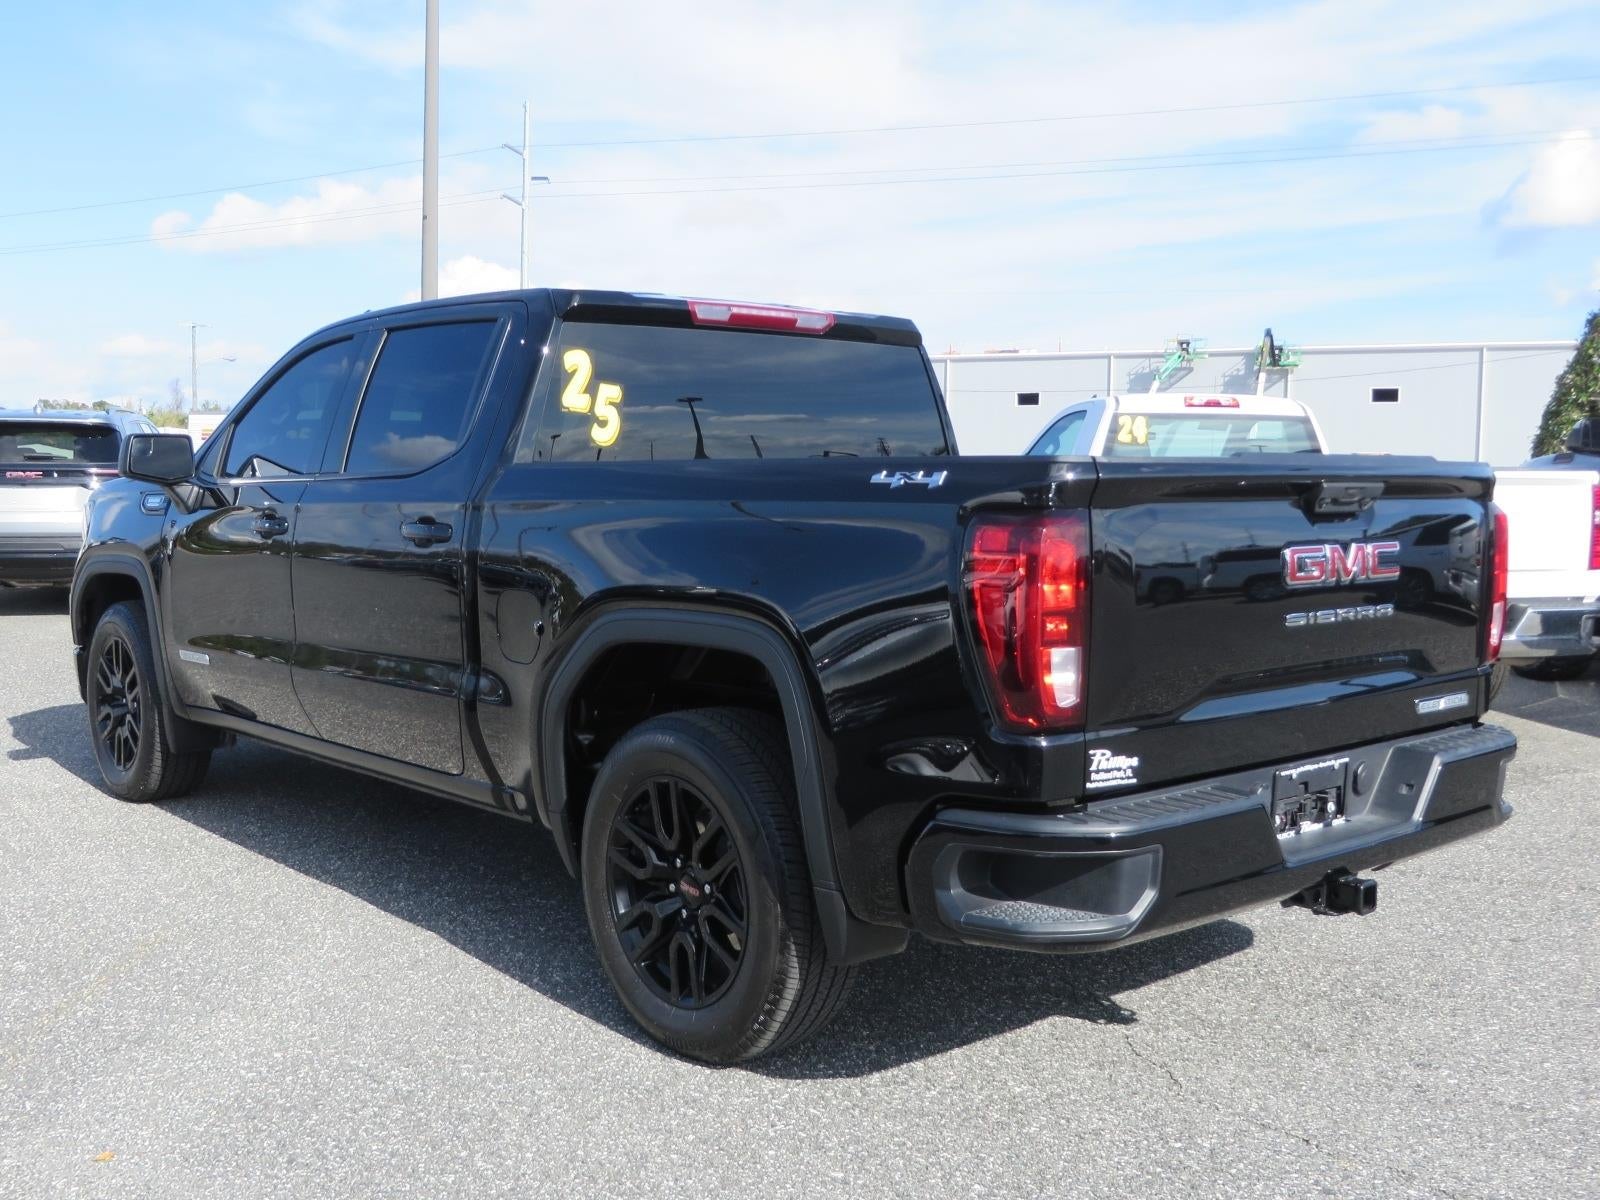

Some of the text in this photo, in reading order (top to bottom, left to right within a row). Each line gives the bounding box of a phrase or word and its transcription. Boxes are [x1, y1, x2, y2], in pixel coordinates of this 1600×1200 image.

[1281, 541, 1400, 589] GMC
[1285, 604, 1394, 627] SIERRA
[1088, 749, 1139, 770] Phillips
